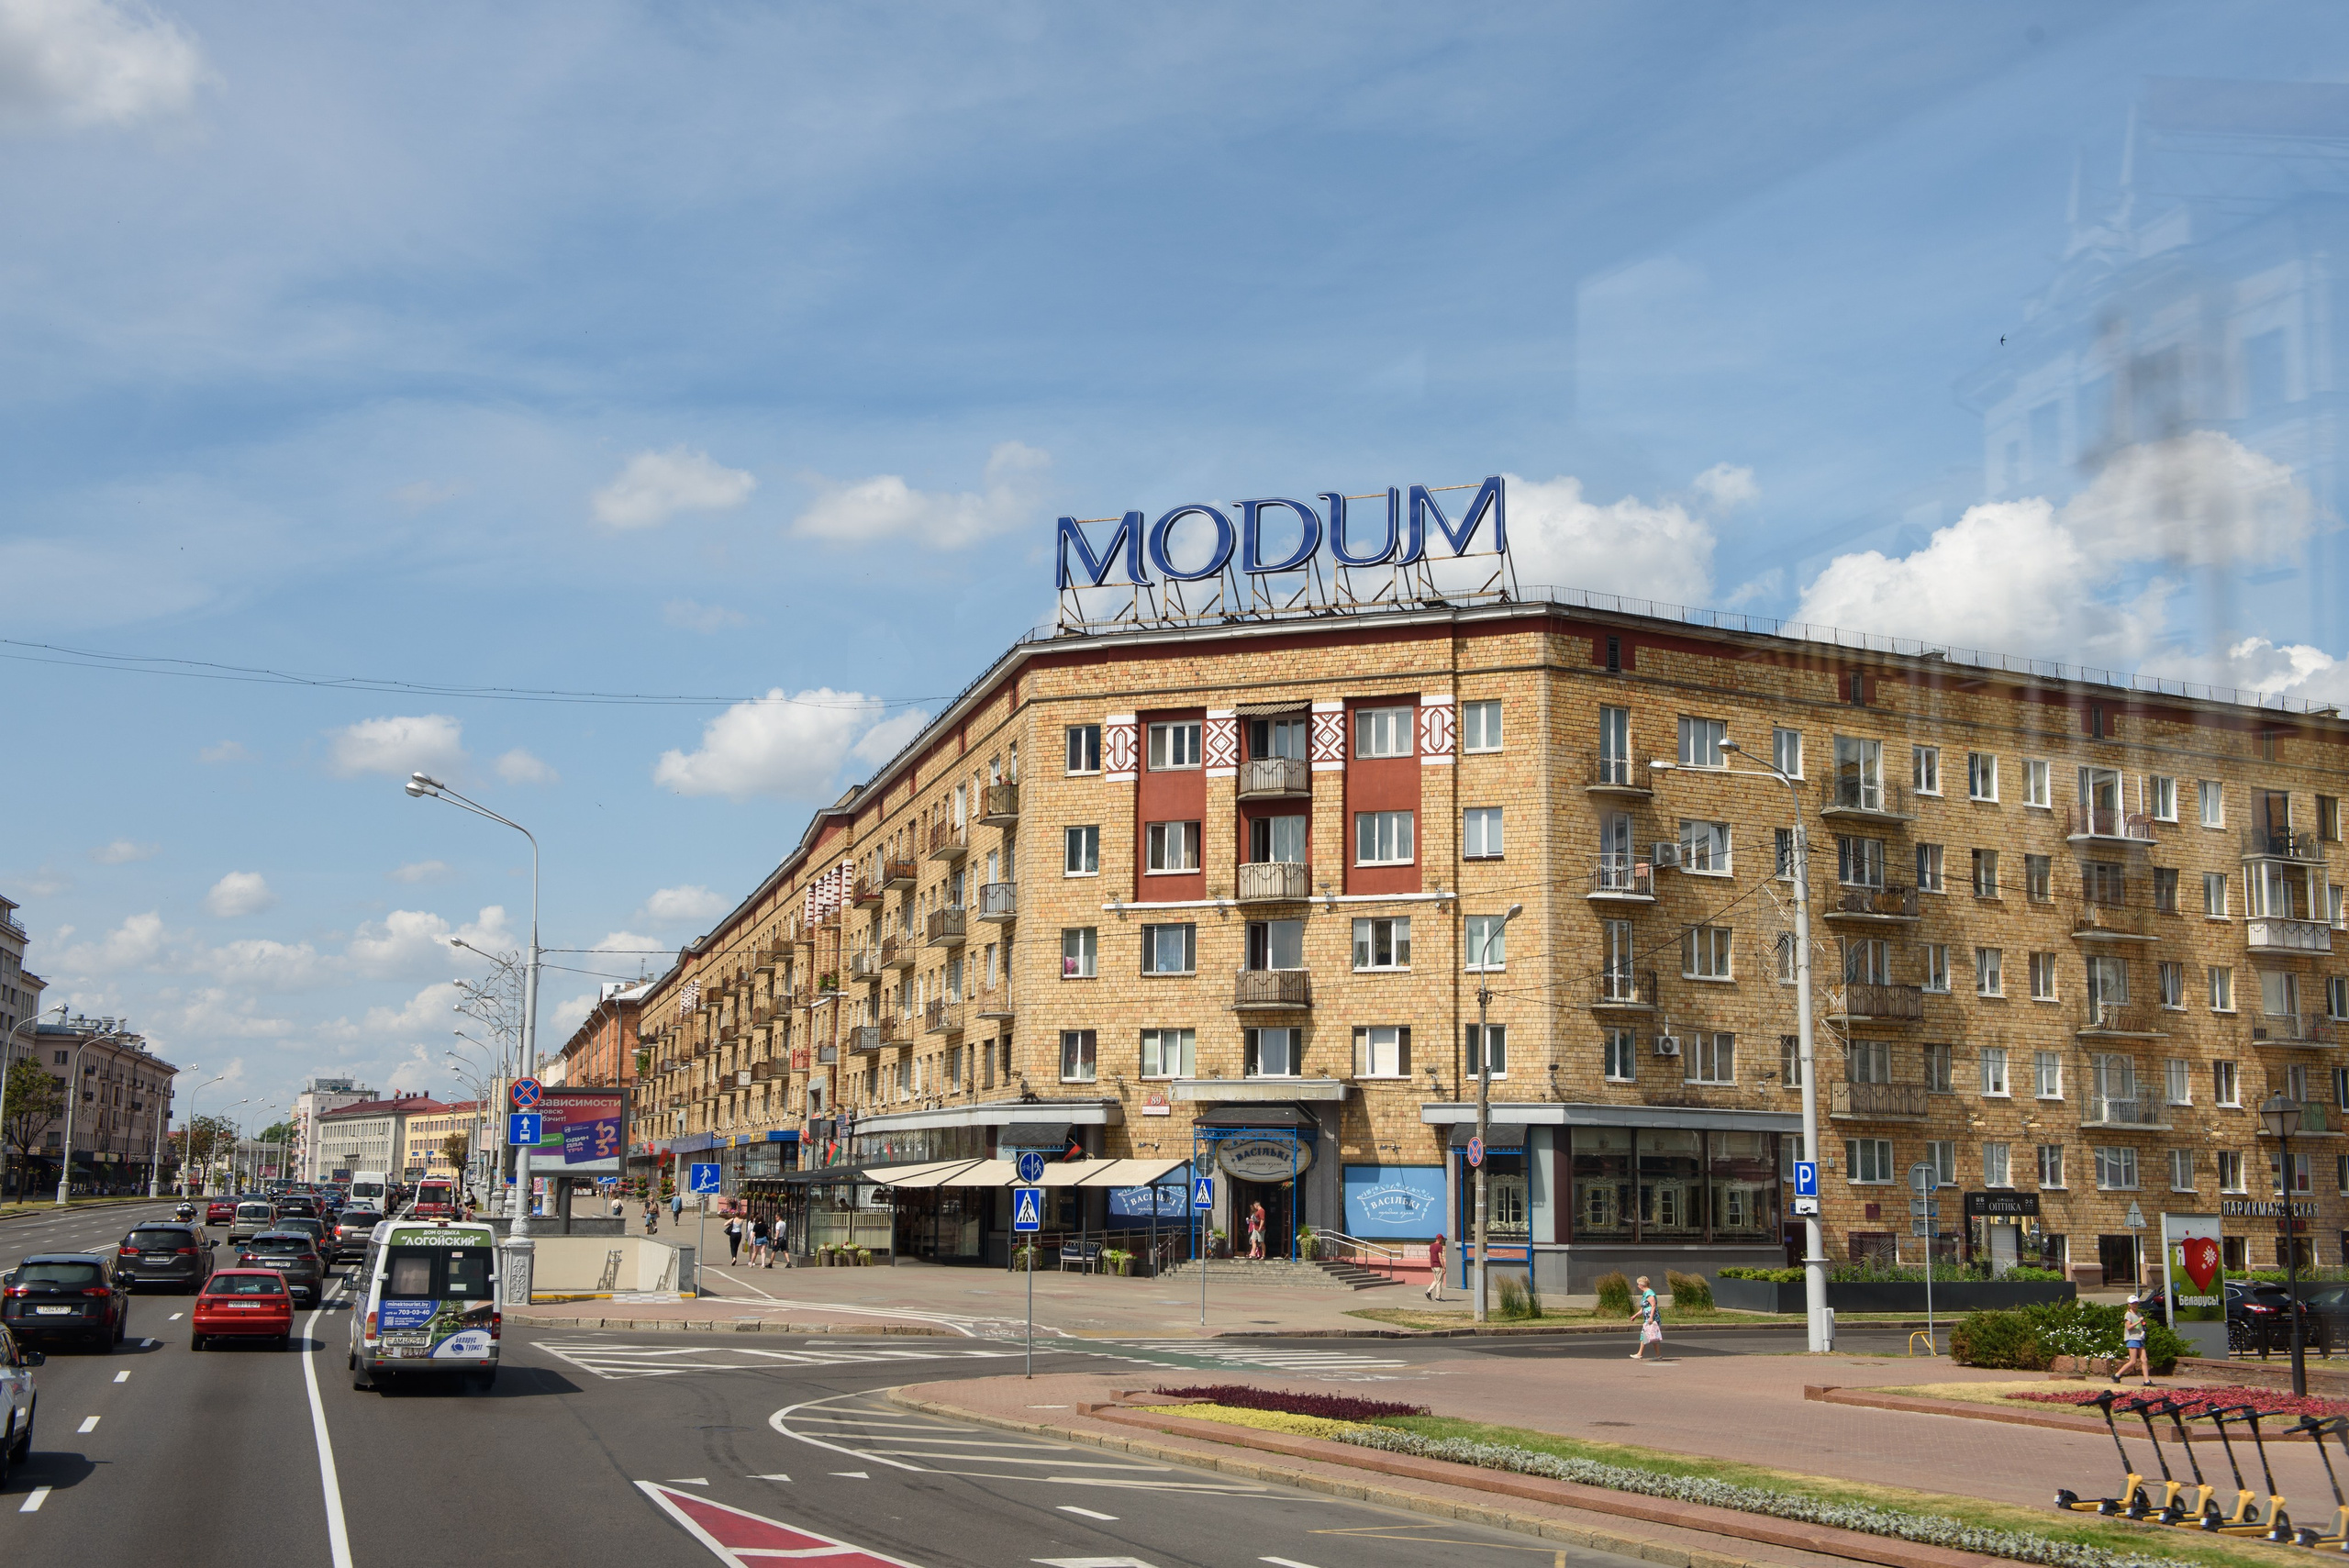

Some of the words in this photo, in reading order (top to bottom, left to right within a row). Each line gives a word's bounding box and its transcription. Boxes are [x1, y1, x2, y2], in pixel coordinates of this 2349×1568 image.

[1055, 474, 1506, 590] MODUM
[536, 1098, 621, 1107] зависимости
[1151, 1095, 1162, 1106] 89
[565, 1135, 589, 1143] ОДИН
[1235, 1147, 1290, 1162] ВАСІЛЬКІ
[1799, 1165, 1812, 1192] P
[1130, 1193, 1176, 1207] ВАСІЬКІ
[1370, 1195, 1420, 1210] ВАСІЛЬКІ
[1988, 1203, 2021, 1211] ОПТИКА
[2223, 1201, 2319, 1218] ПАРИКМАХЕСКАЯ
[2176, 1245, 2186, 1266] Я
[2178, 1295, 2220, 1307] Беларусь!
